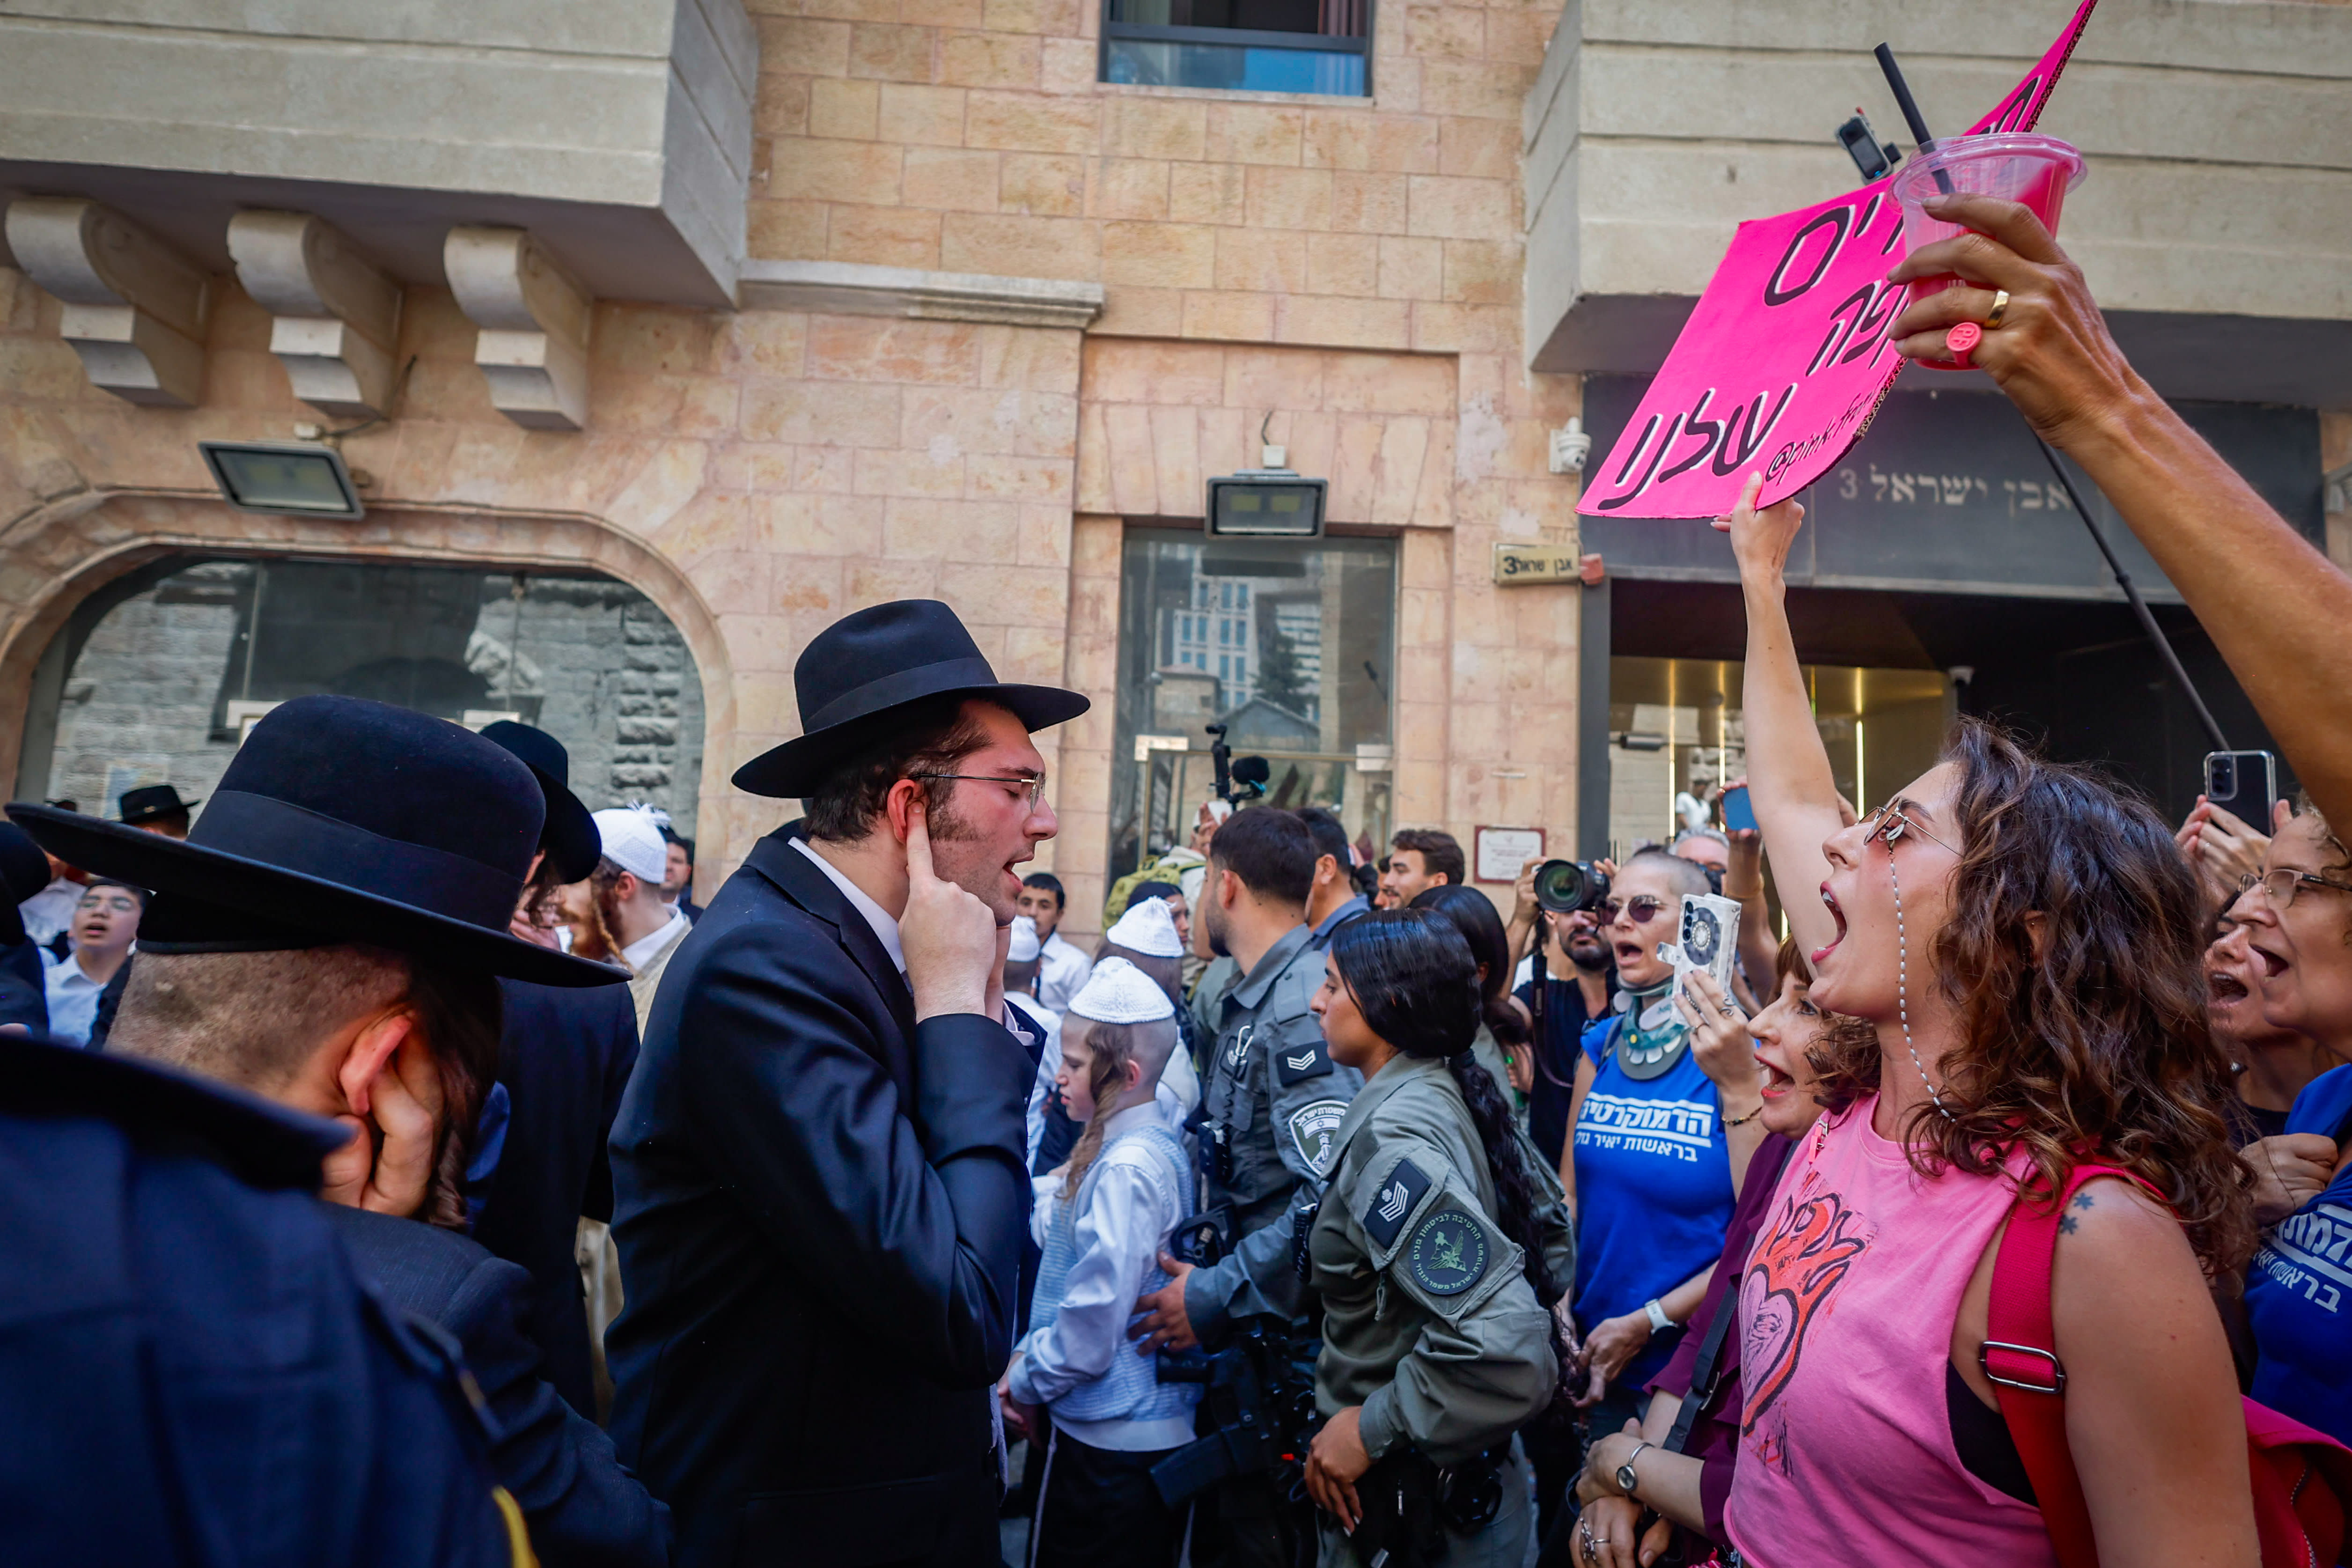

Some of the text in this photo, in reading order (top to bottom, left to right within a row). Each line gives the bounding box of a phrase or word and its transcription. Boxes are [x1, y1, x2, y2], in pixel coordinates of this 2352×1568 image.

[1597, 382, 1798, 510] שלנו
[1839, 463, 2072, 516] אבן ישראל 3
[1503, 556, 1517, 574] 3
[1594, 1134, 1621, 1148] יאיר
[1624, 1136, 1698, 1162] בראשות
[1413, 1214, 1482, 1260] החטיבה לביטחון פנים
[1416, 1243, 1484, 1289] משטרת ישראל משמר הגבול
